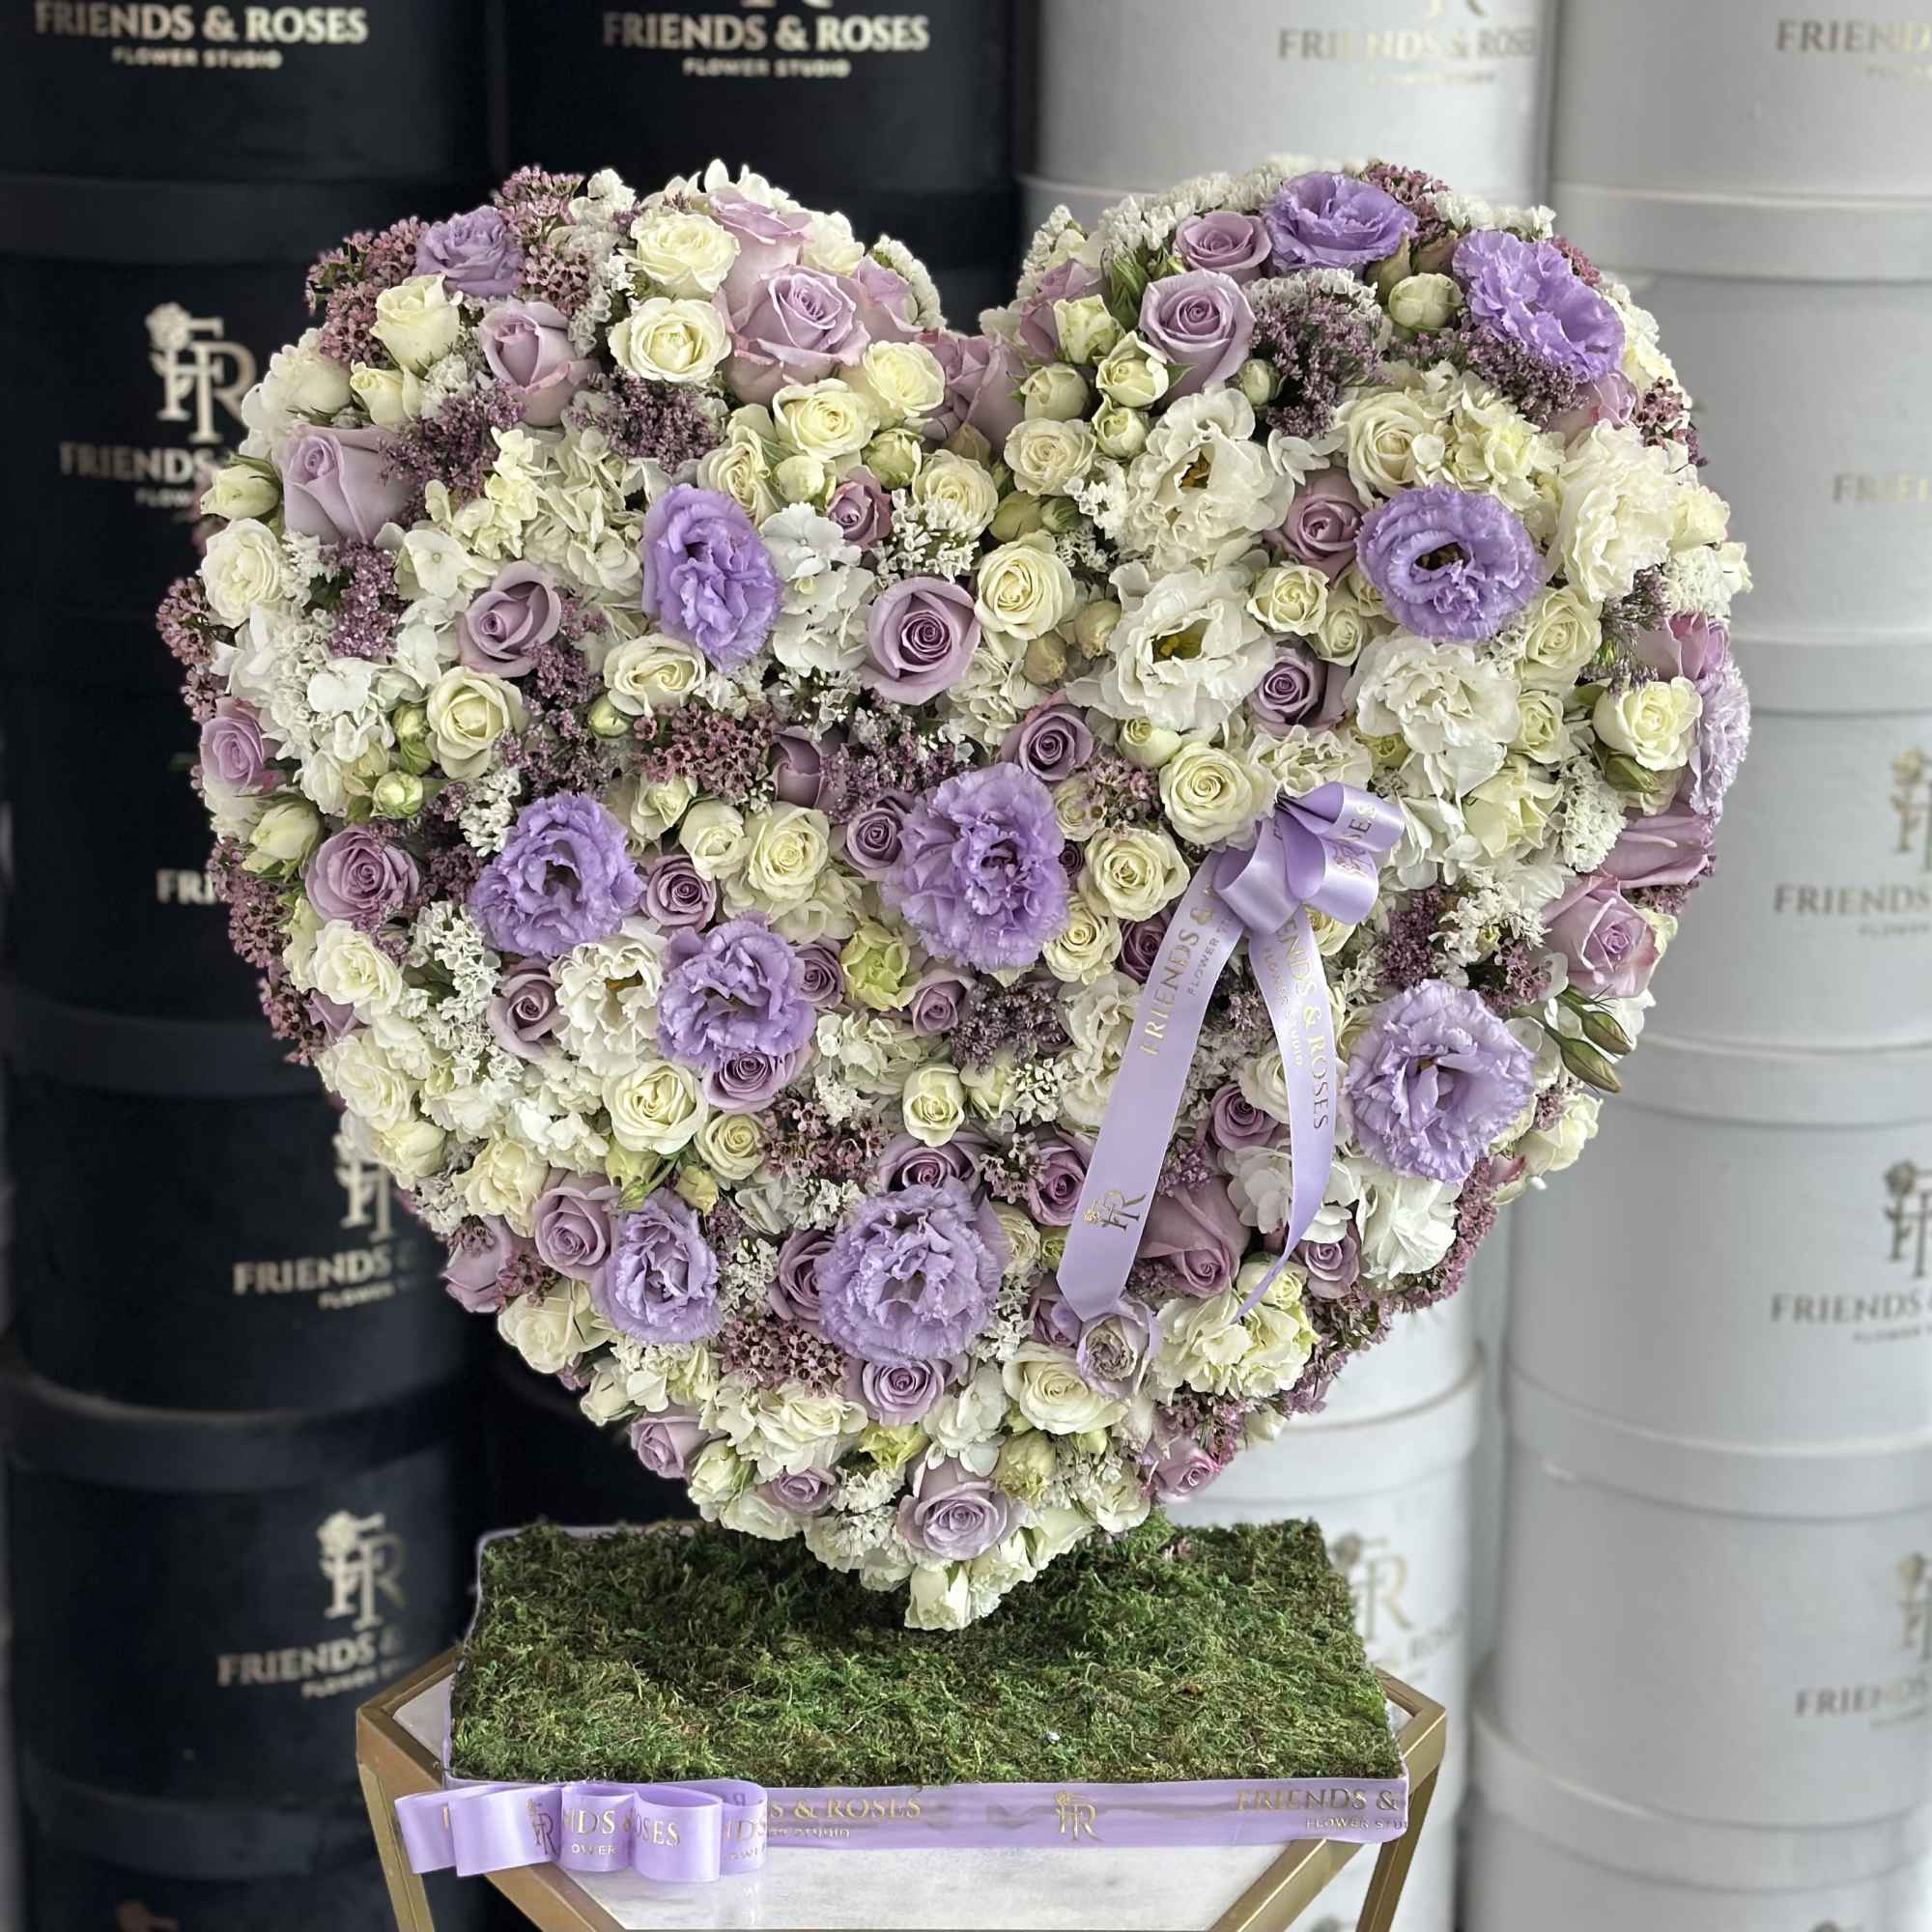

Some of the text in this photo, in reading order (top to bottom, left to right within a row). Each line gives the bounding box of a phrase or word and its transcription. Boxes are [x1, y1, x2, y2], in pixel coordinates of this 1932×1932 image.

[35, 1, 368, 43] FRIENDS & ROSES
[603, 12, 930, 51] FRIENDS & ROSES
[1277, 28, 1441, 61] FRINDS
[1187, 937, 1222, 996] FLOWER
[1308, 1035, 1329, 1130] ROSES
[232, 1245, 392, 1295] FRIENDS
[216, 1632, 376, 1687] FRIENDS
[793, 1799, 817, 1820] &
[1236, 1787, 1400, 1811] FRIENDS &
